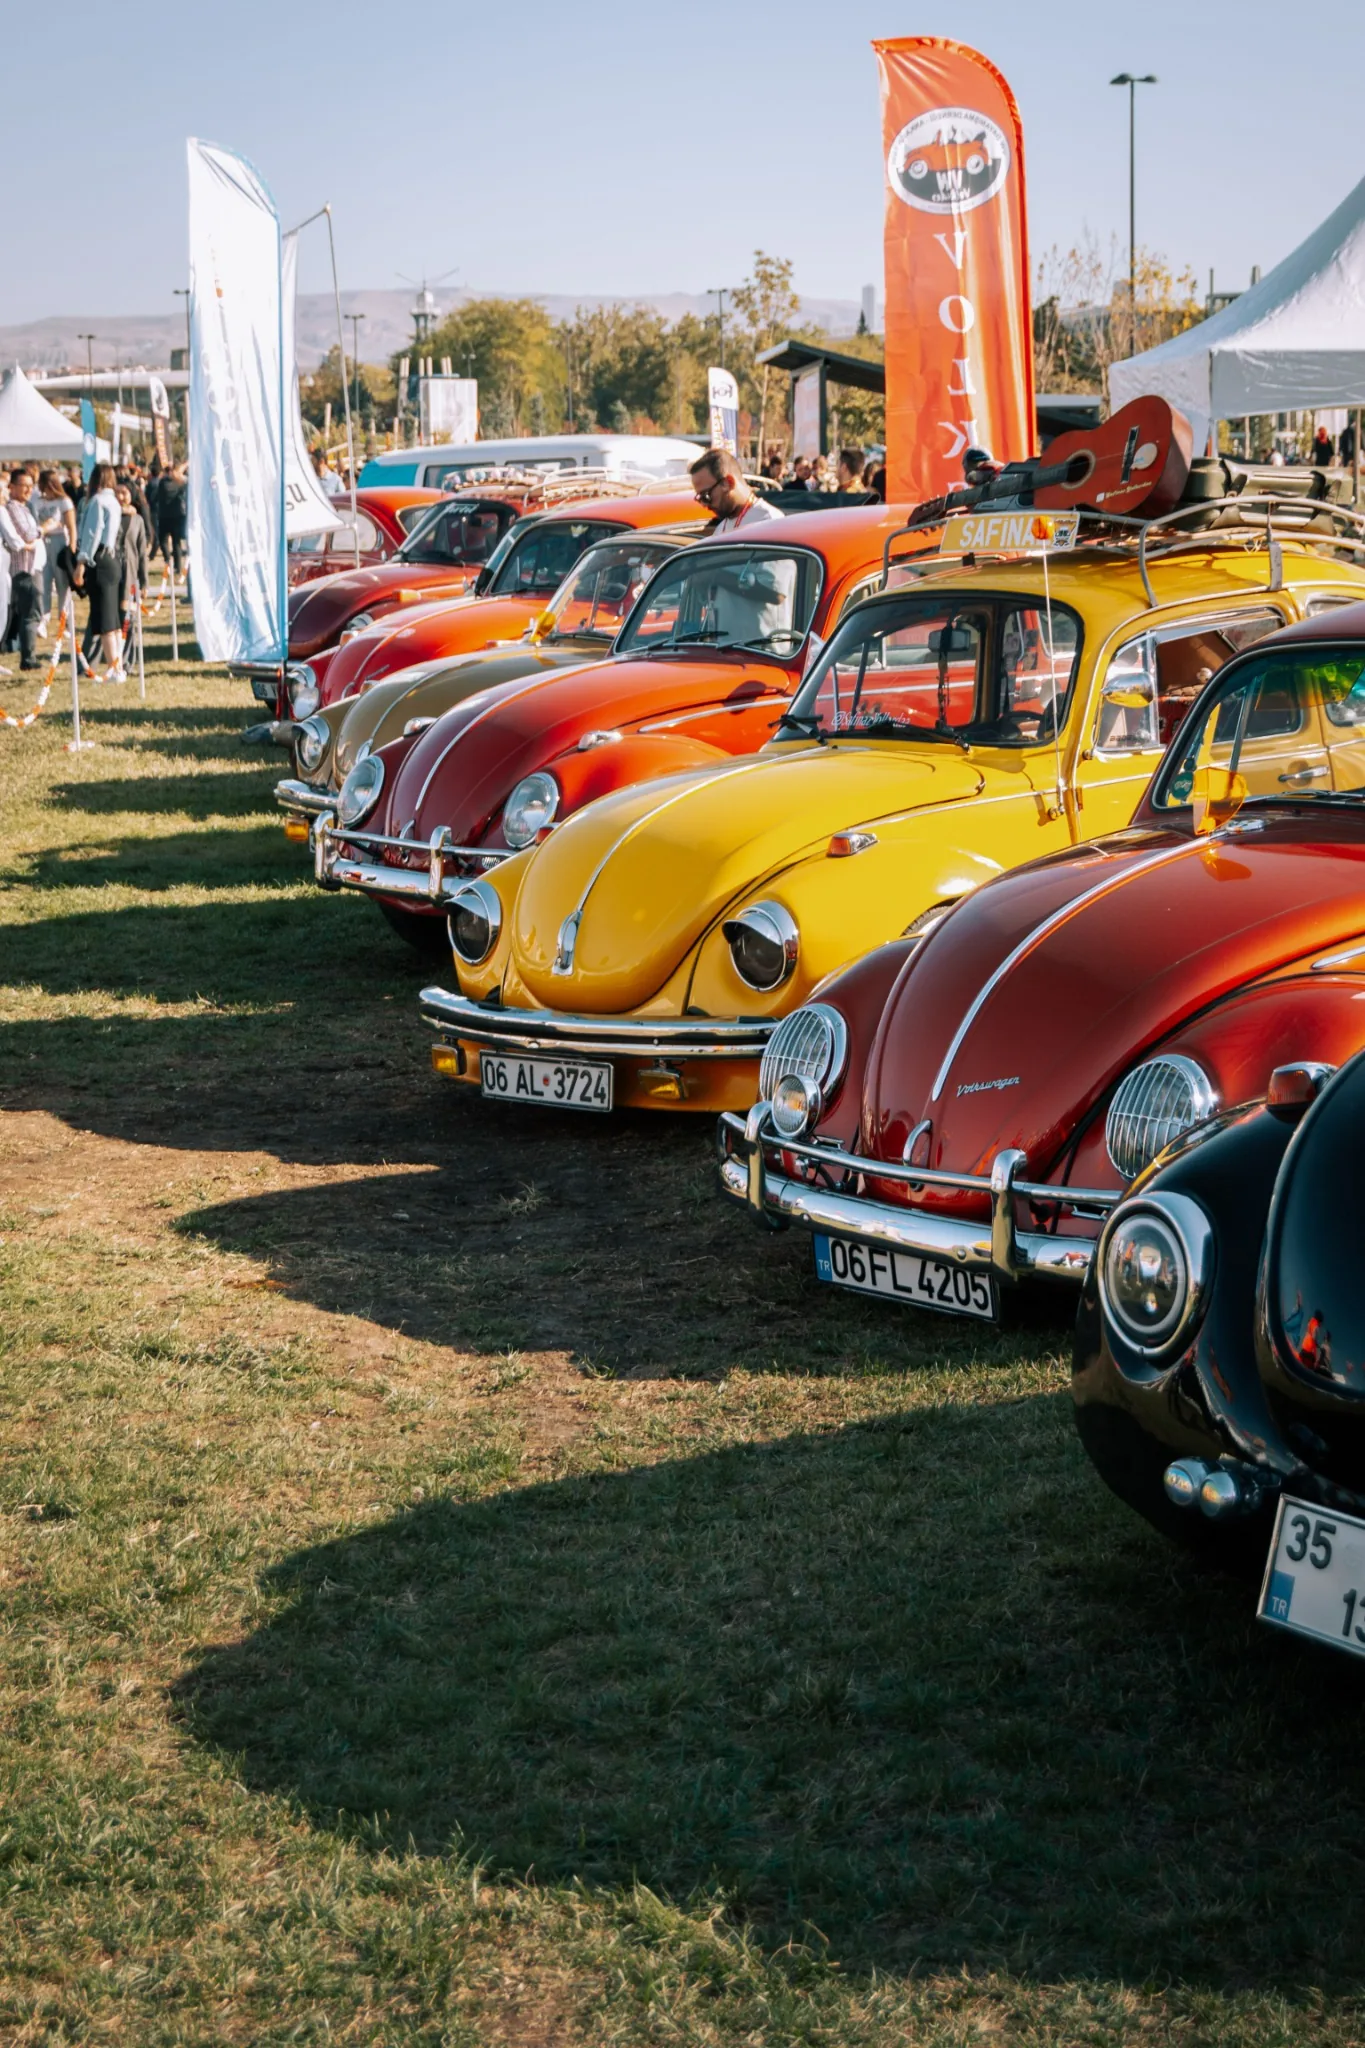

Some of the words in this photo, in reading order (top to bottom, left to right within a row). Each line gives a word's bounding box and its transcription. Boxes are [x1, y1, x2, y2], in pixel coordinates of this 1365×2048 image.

[959, 516, 1050, 548] SAFİNA
[484, 1058, 508, 1092] 06
[516, 1063, 544, 1097] AL
[553, 1066, 607, 1104] 3724
[956, 1076, 1020, 1098] Volkswagen
[818, 1258, 831, 1272] TR
[918, 1259, 989, 1311] 4205
[1285, 1513, 1337, 1570] 35
[1272, 1596, 1288, 1616] TR
